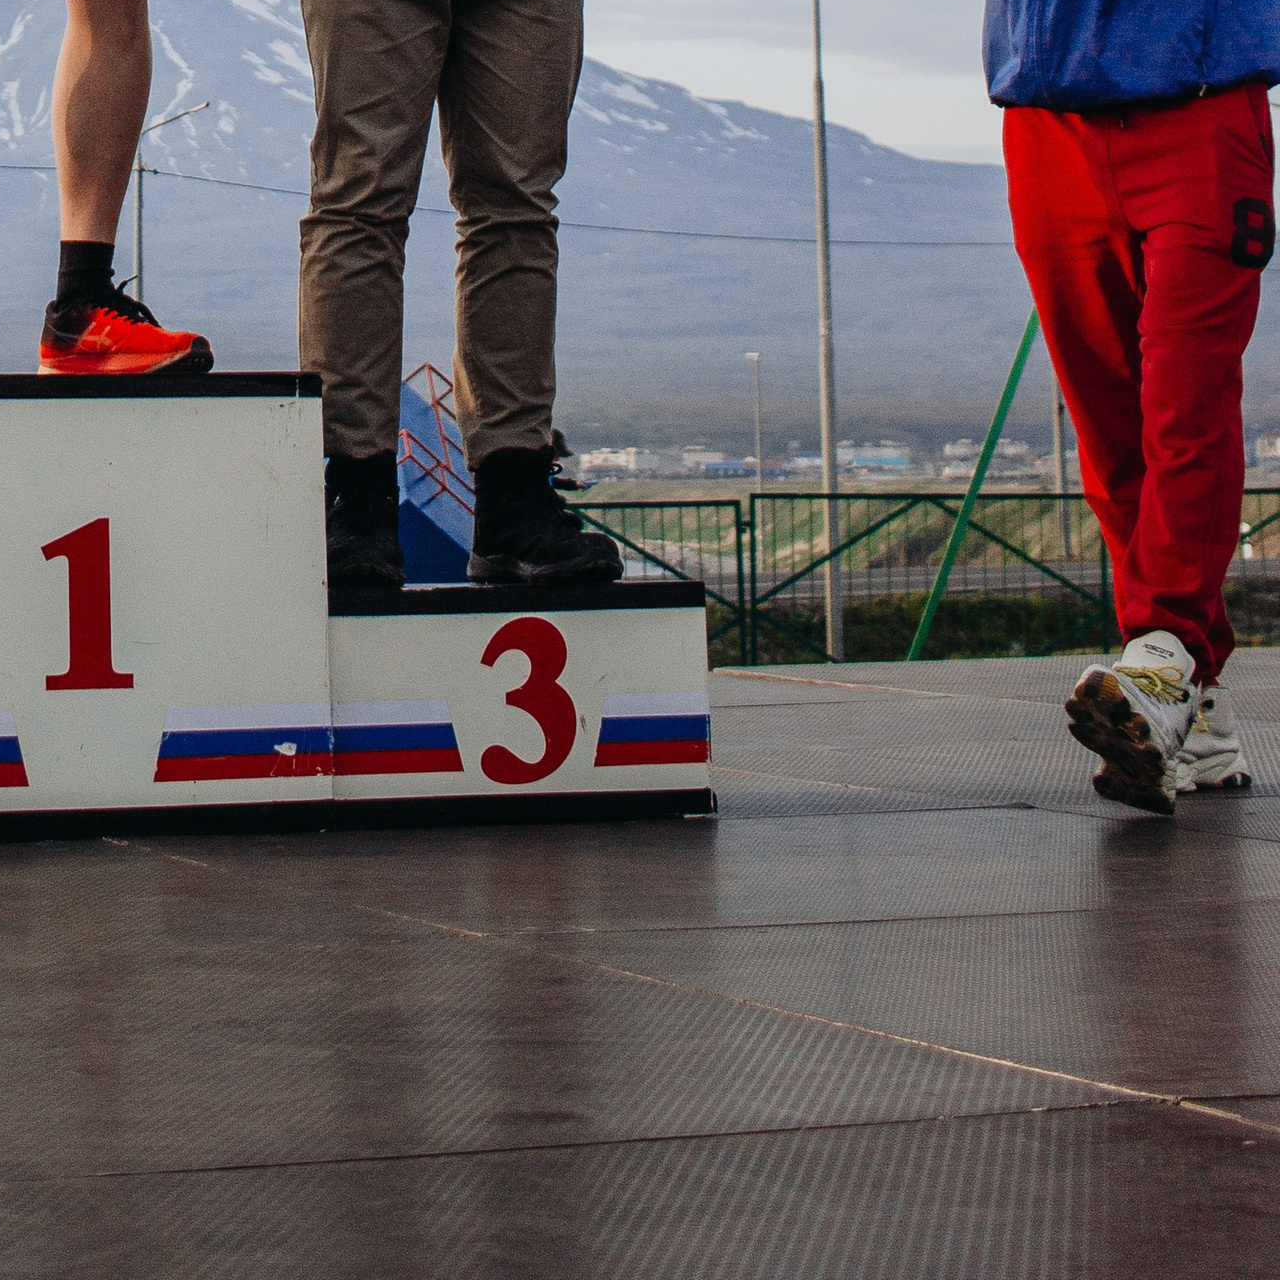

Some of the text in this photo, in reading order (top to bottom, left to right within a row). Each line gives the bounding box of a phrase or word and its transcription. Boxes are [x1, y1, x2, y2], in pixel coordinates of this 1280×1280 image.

[1230, 197, 1276, 269] 8
[40, 518, 134, 690] 1
[480, 617, 577, 785] 3
